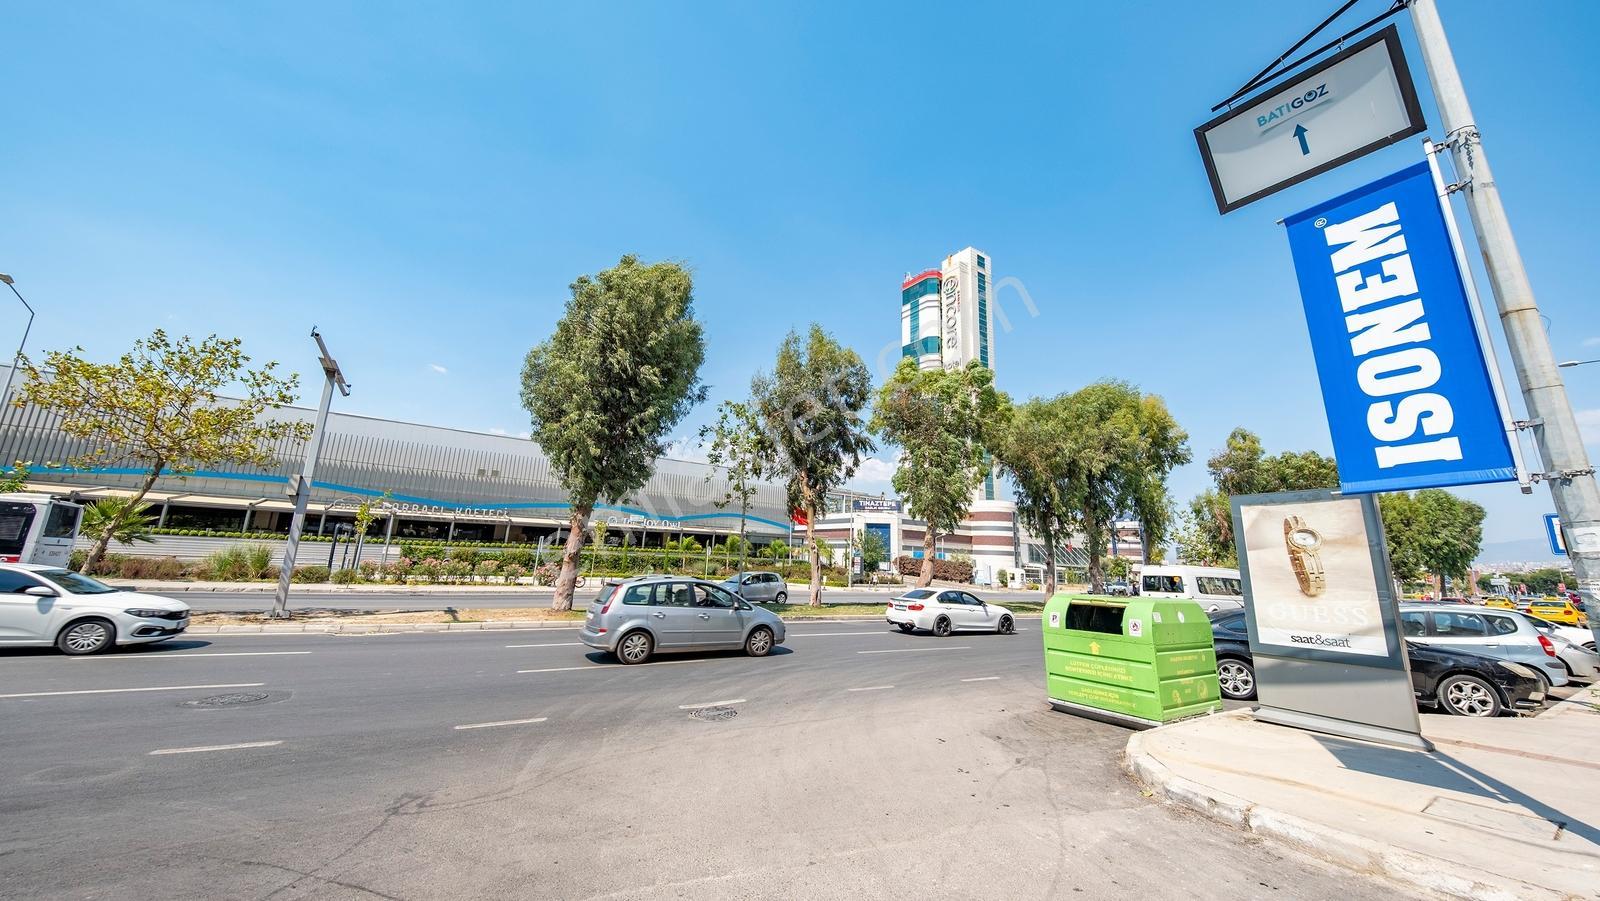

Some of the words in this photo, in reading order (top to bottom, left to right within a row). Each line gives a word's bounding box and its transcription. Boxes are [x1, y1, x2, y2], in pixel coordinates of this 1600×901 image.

[1323, 201, 1463, 469] ISONEM
[1268, 601, 1369, 627] GUESS
[1290, 634, 1352, 648] saat&saat
